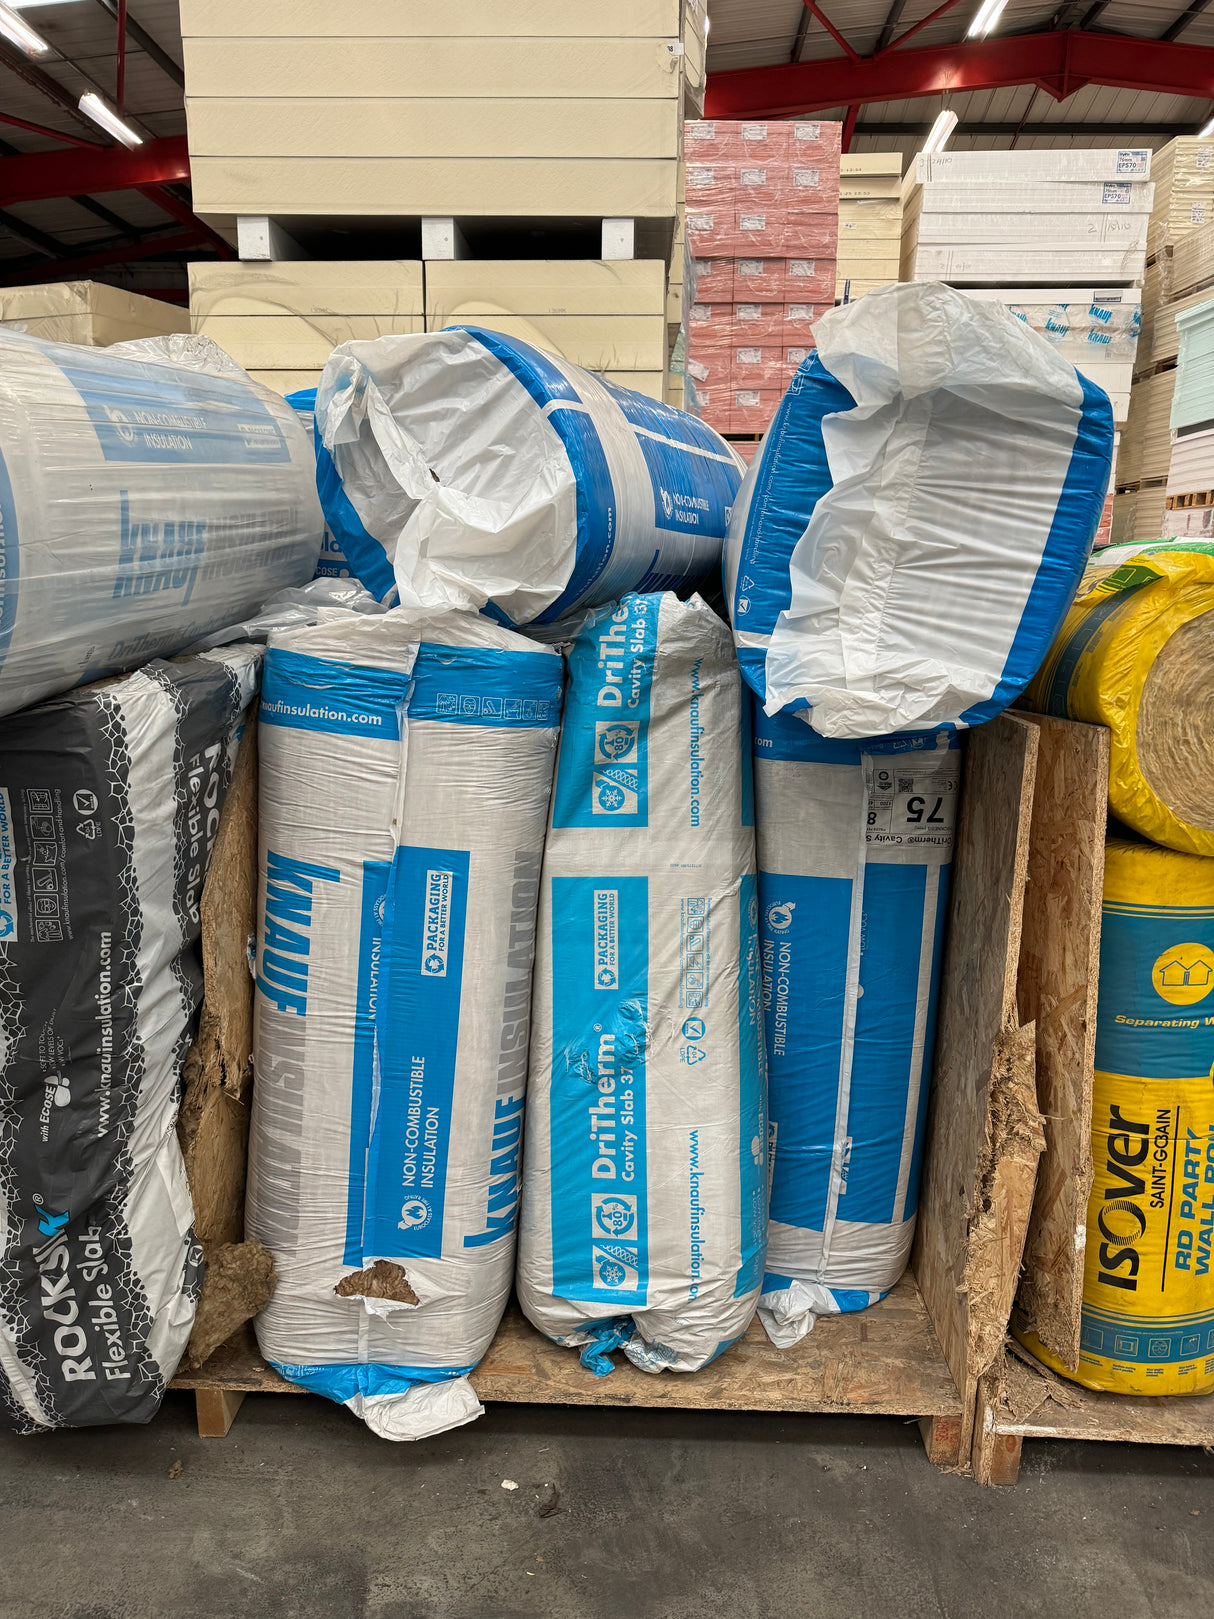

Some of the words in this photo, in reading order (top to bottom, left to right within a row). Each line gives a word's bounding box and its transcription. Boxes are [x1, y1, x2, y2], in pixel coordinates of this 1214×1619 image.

[315, 566, 338, 577] COSE
[597, 596, 632, 707] DriThe
[630, 618, 646, 653] Slab
[627, 658, 645, 708] Cavity
[868, 811, 877, 826] 8
[906, 796, 944, 824] 75
[0, 835, 12, 871] BETTER
[874, 834, 903, 844] Cavity
[1, 881, 12, 905] FOR
[185, 863, 201, 925] Slab
[427, 873, 442, 952] PACKAGING
[441, 874, 449, 902] WORLD
[256, 848, 341, 1017] KNAUF
[438, 935, 446, 952] FOR
[597, 892, 608, 966] PACKAGING
[762, 938, 775, 1012] INSULATION
[773, 941, 792, 1056] NON-COMBUSTIBLE
[94, 931, 113, 1139] www.knauinsulation.com
[1114, 1014, 1200, 1029] Separating
[463, 1095, 527, 1248] KNAUF
[496, 850, 541, 1096] INSULATION
[620, 1065, 634, 1085] 37
[39, 1085, 57, 1124] ECOSE
[402, 1055, 425, 1187] NON-COMBUSTIBLE
[620, 1090, 634, 1125] Slab
[40, 1125, 50, 1142] with
[421, 1106, 440, 1188] INSULATION
[621, 1130, 638, 1182] Cavity
[1150, 1109, 1172, 1209] SAINT-GOBAIN
[1180, 1127, 1201, 1221] PARTY
[76, 1226, 109, 1282] Slab
[1174, 1230, 1194, 1271] RD
[1195, 1195, 1214, 1276] WALL
[88, 1283, 132, 1381] Flexible
